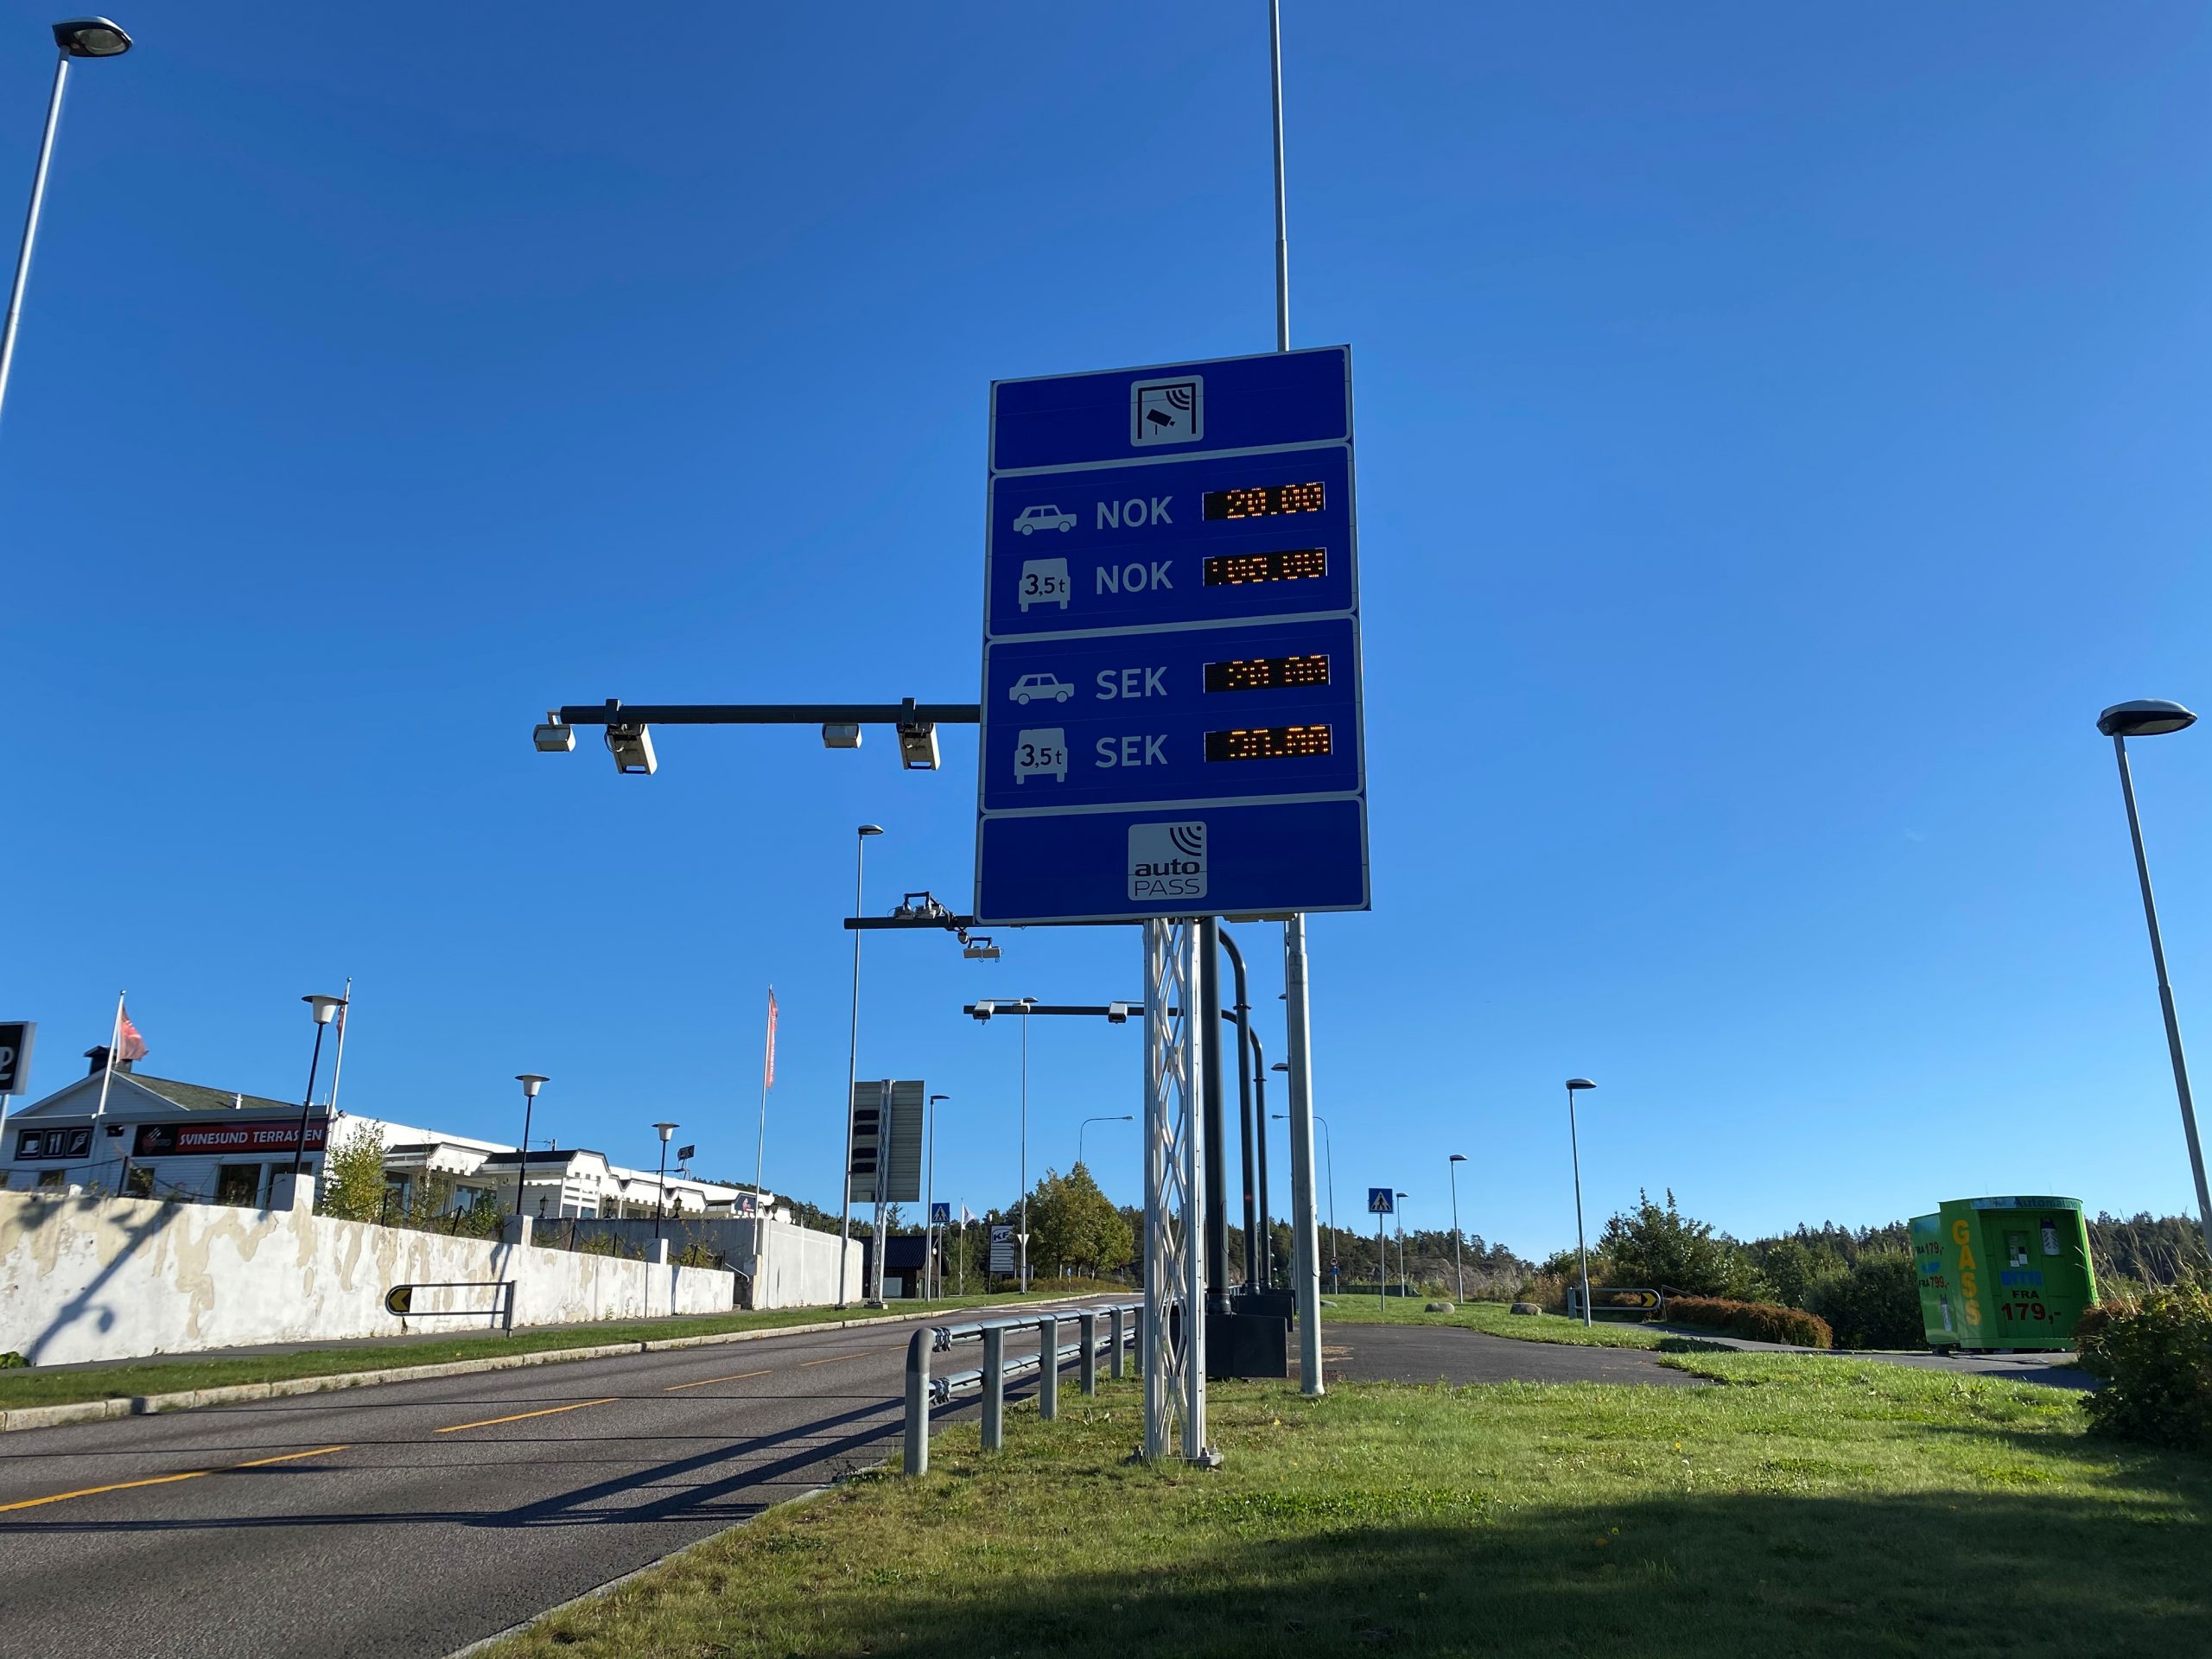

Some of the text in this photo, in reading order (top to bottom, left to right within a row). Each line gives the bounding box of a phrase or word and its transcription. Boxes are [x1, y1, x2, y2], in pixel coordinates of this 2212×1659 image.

[1096, 496, 1173, 530] NOK
[1227, 482, 1321, 518] 20.00
[1096, 561, 1173, 594] NOK
[1096, 666, 1167, 701] SEK
[1095, 734, 1168, 768] SEK
[1135, 858, 1200, 878] auto
[1135, 878, 1200, 897] PASS
[180, 1132, 248, 1146] SVINESUND
[253, 1129, 322, 1143] TERRASEN
[1952, 1219, 1981, 1326] GASS
[2012, 1290, 2039, 1300] FRA
[2001, 1302, 2062, 1325] 179,-
